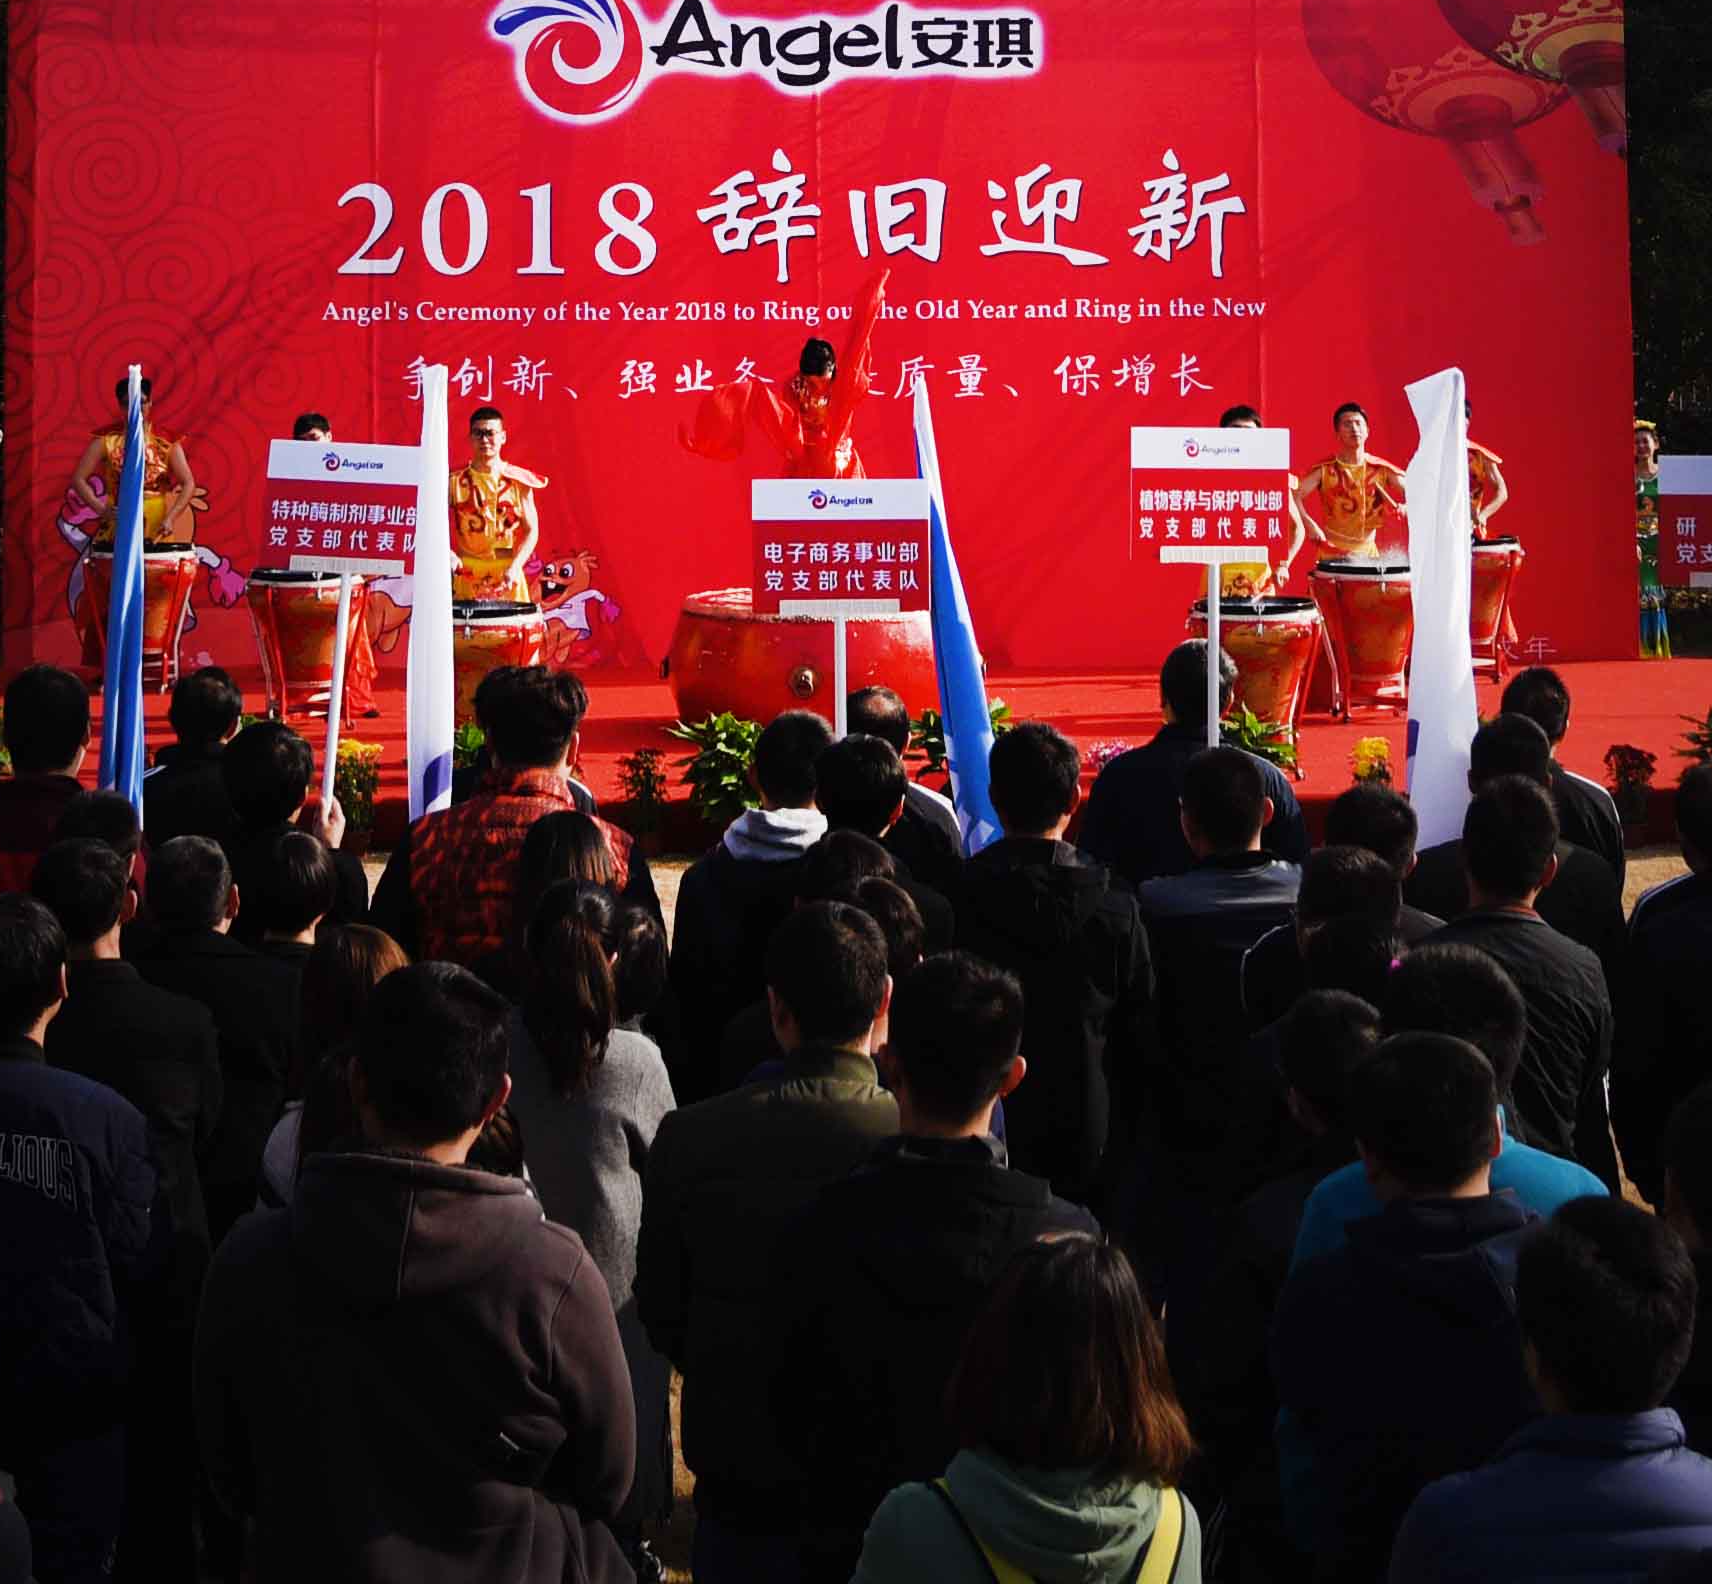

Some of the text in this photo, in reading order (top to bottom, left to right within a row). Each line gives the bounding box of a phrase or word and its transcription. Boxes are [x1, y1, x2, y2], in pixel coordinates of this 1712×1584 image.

[910, 16, 1035, 69] 安琪
[337, 148, 1245, 283] 2018 辞旧迎新
[322, 297, 1266, 327] Angel's Ceremony of the Year 2018 to Ring ou he Old Year and Ring in the New
[272, 499, 418, 526] 特种酶制剂事业部
[1139, 489, 1283, 512] 植物营养与保护事业部
[269, 525, 417, 553] 党支部代表队
[1139, 517, 1282, 539] 党支部代表队
[764, 541, 919, 564] 电子商务事业部
[764, 569, 919, 592] 党支部代表队
